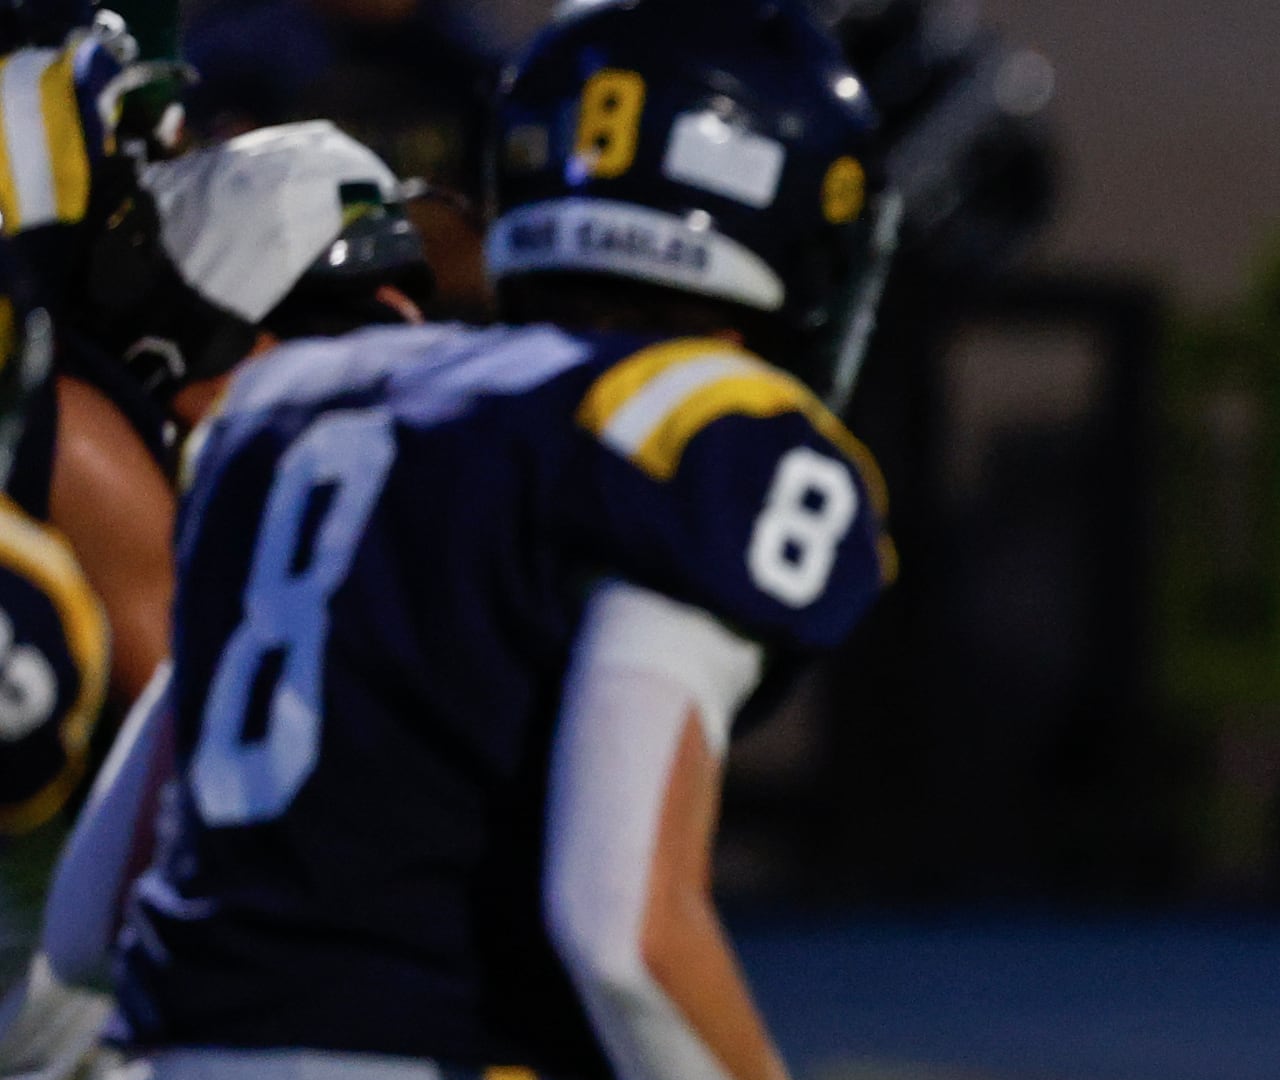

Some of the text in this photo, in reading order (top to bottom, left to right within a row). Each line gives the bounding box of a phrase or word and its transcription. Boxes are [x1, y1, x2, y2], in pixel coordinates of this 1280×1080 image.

[573, 67, 647, 180] 8
[747, 446, 859, 608] 8
[189, 405, 397, 827] 8
